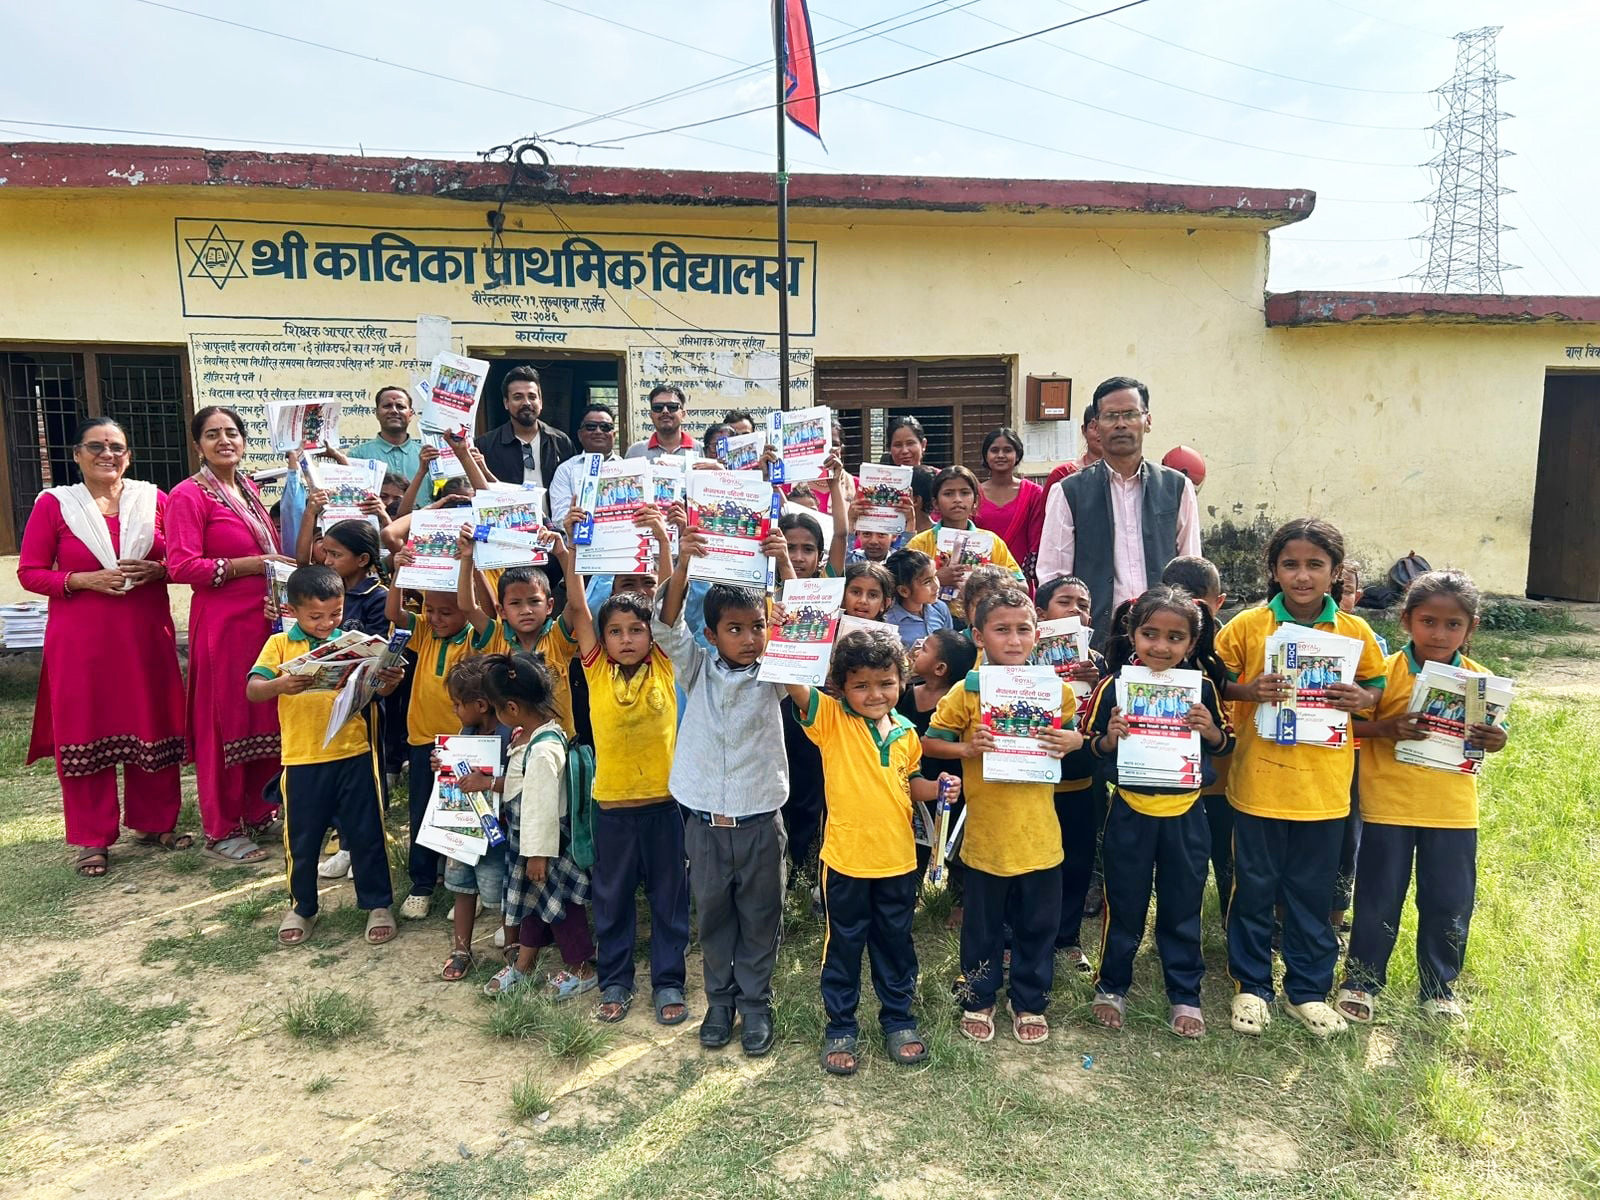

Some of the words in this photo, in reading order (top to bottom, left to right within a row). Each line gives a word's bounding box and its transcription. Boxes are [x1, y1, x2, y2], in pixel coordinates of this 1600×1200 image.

[251, 230, 308, 280] श्री
[313, 232, 478, 284] कालिका
[481, 237, 647, 290] प्राथमिक
[648, 240, 805, 297] विद्यालय
[283, 321, 321, 339] शिक्षक
[322, 326, 355, 339] आचार
[356, 325, 389, 341] संहिता
[515, 328, 569, 344] कार्यालय
[678, 333, 714, 347] अभिभावक
[714, 339, 742, 349] आचार
[741, 336, 766, 352] संहिता
[1288, 644, 1296, 668] DOMS
[1284, 725, 1294, 740] X1
